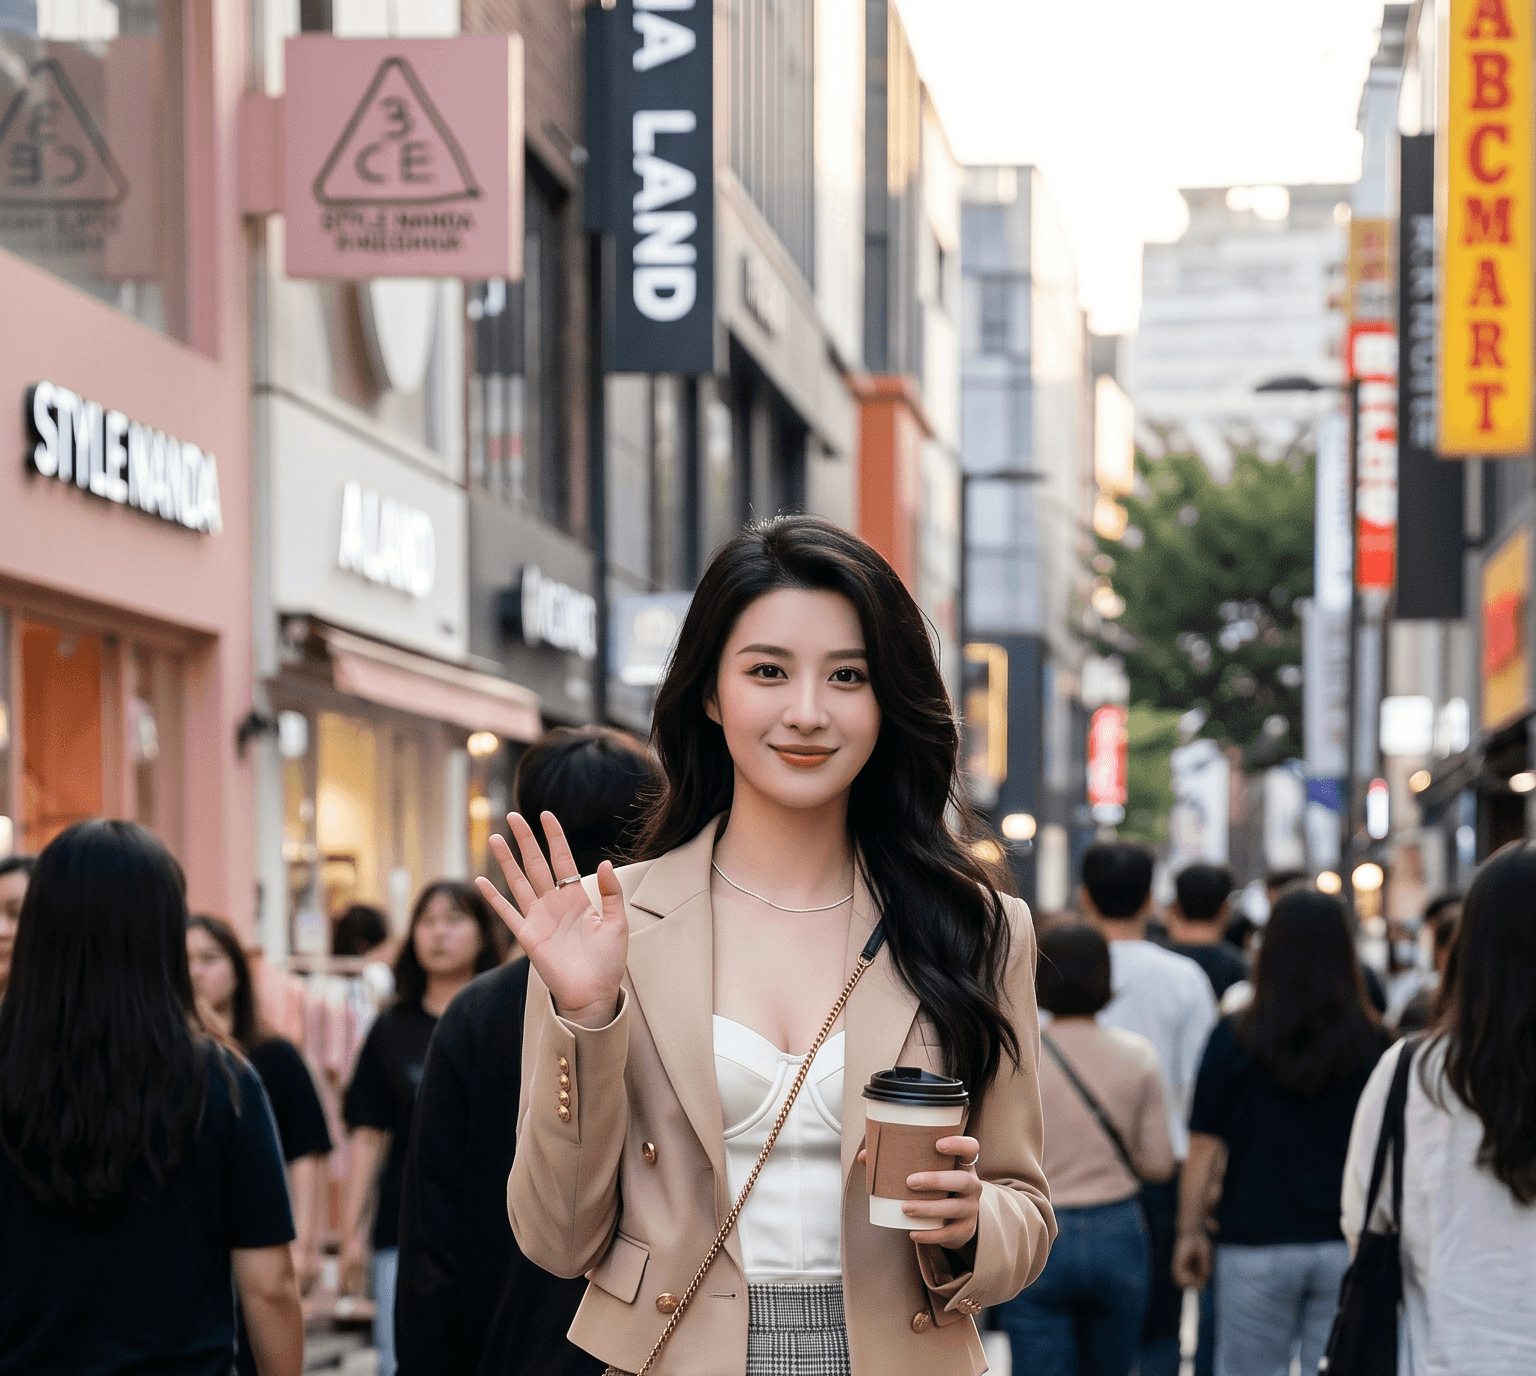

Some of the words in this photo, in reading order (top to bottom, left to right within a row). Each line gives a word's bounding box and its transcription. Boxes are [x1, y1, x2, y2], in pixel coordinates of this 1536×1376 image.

[633, 0, 697, 72] A
[380, 97, 414, 141] 3
[633, 110, 697, 322] LAND
